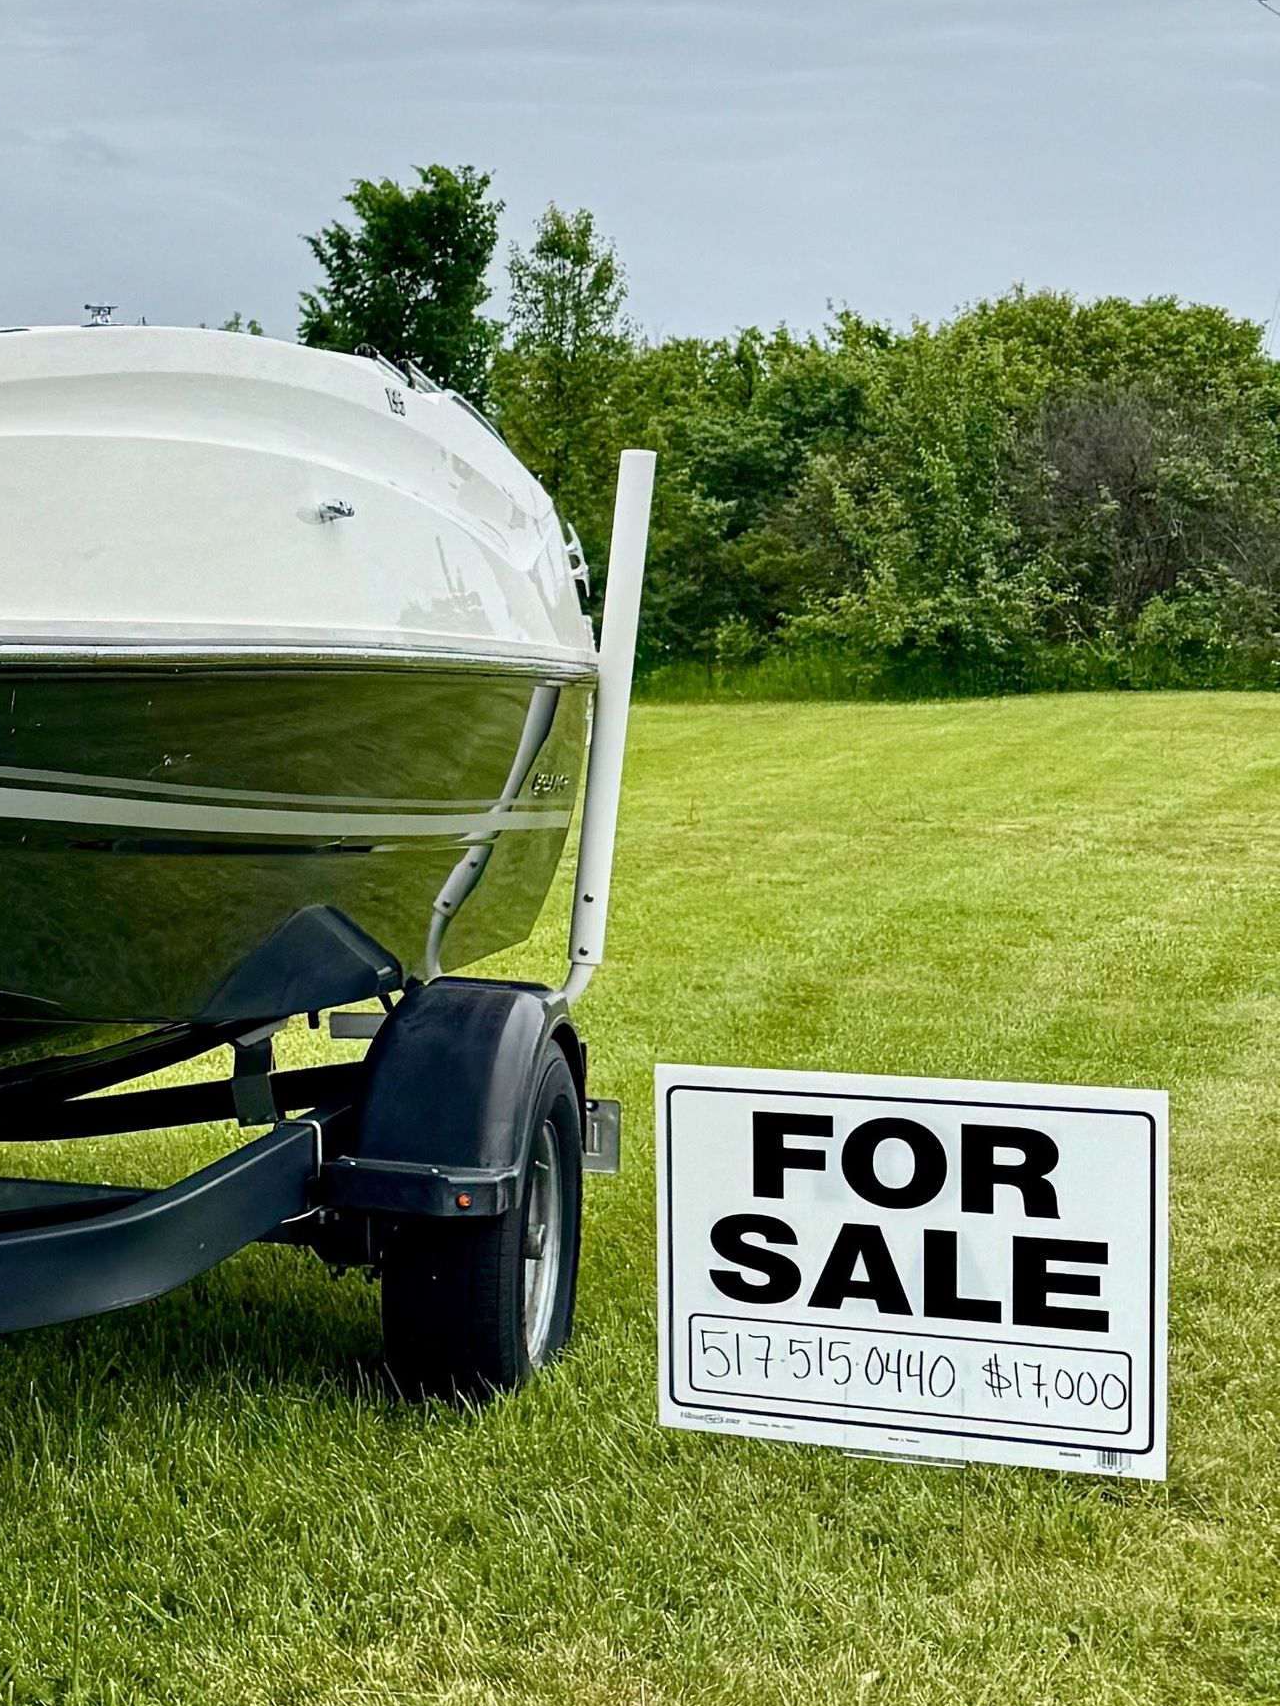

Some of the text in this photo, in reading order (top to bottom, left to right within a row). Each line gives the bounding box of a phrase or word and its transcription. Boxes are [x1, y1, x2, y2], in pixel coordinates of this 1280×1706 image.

[752, 1110, 1061, 1220] FOR
[708, 1213, 1110, 1333] SALE
[982, 1353, 1128, 1410] $17,000
